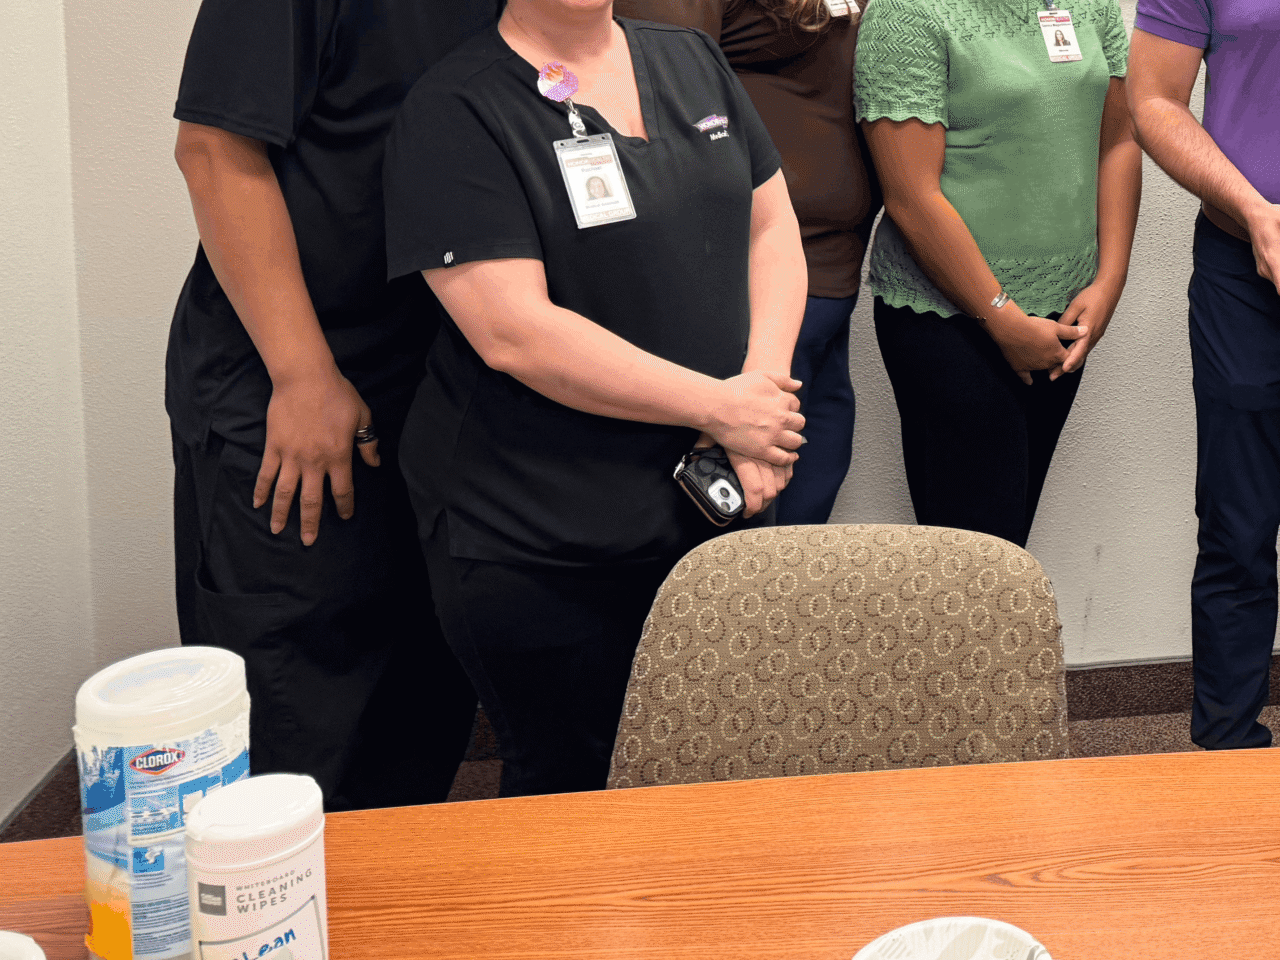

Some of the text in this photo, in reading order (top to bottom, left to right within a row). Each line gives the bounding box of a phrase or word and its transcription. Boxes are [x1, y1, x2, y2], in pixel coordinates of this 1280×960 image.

[135, 751, 179, 769] CLOROX
[236, 870, 295, 891] WHITEBOARD
[236, 868, 312, 903] CLEANING
[236, 893, 287, 914] WIPES
